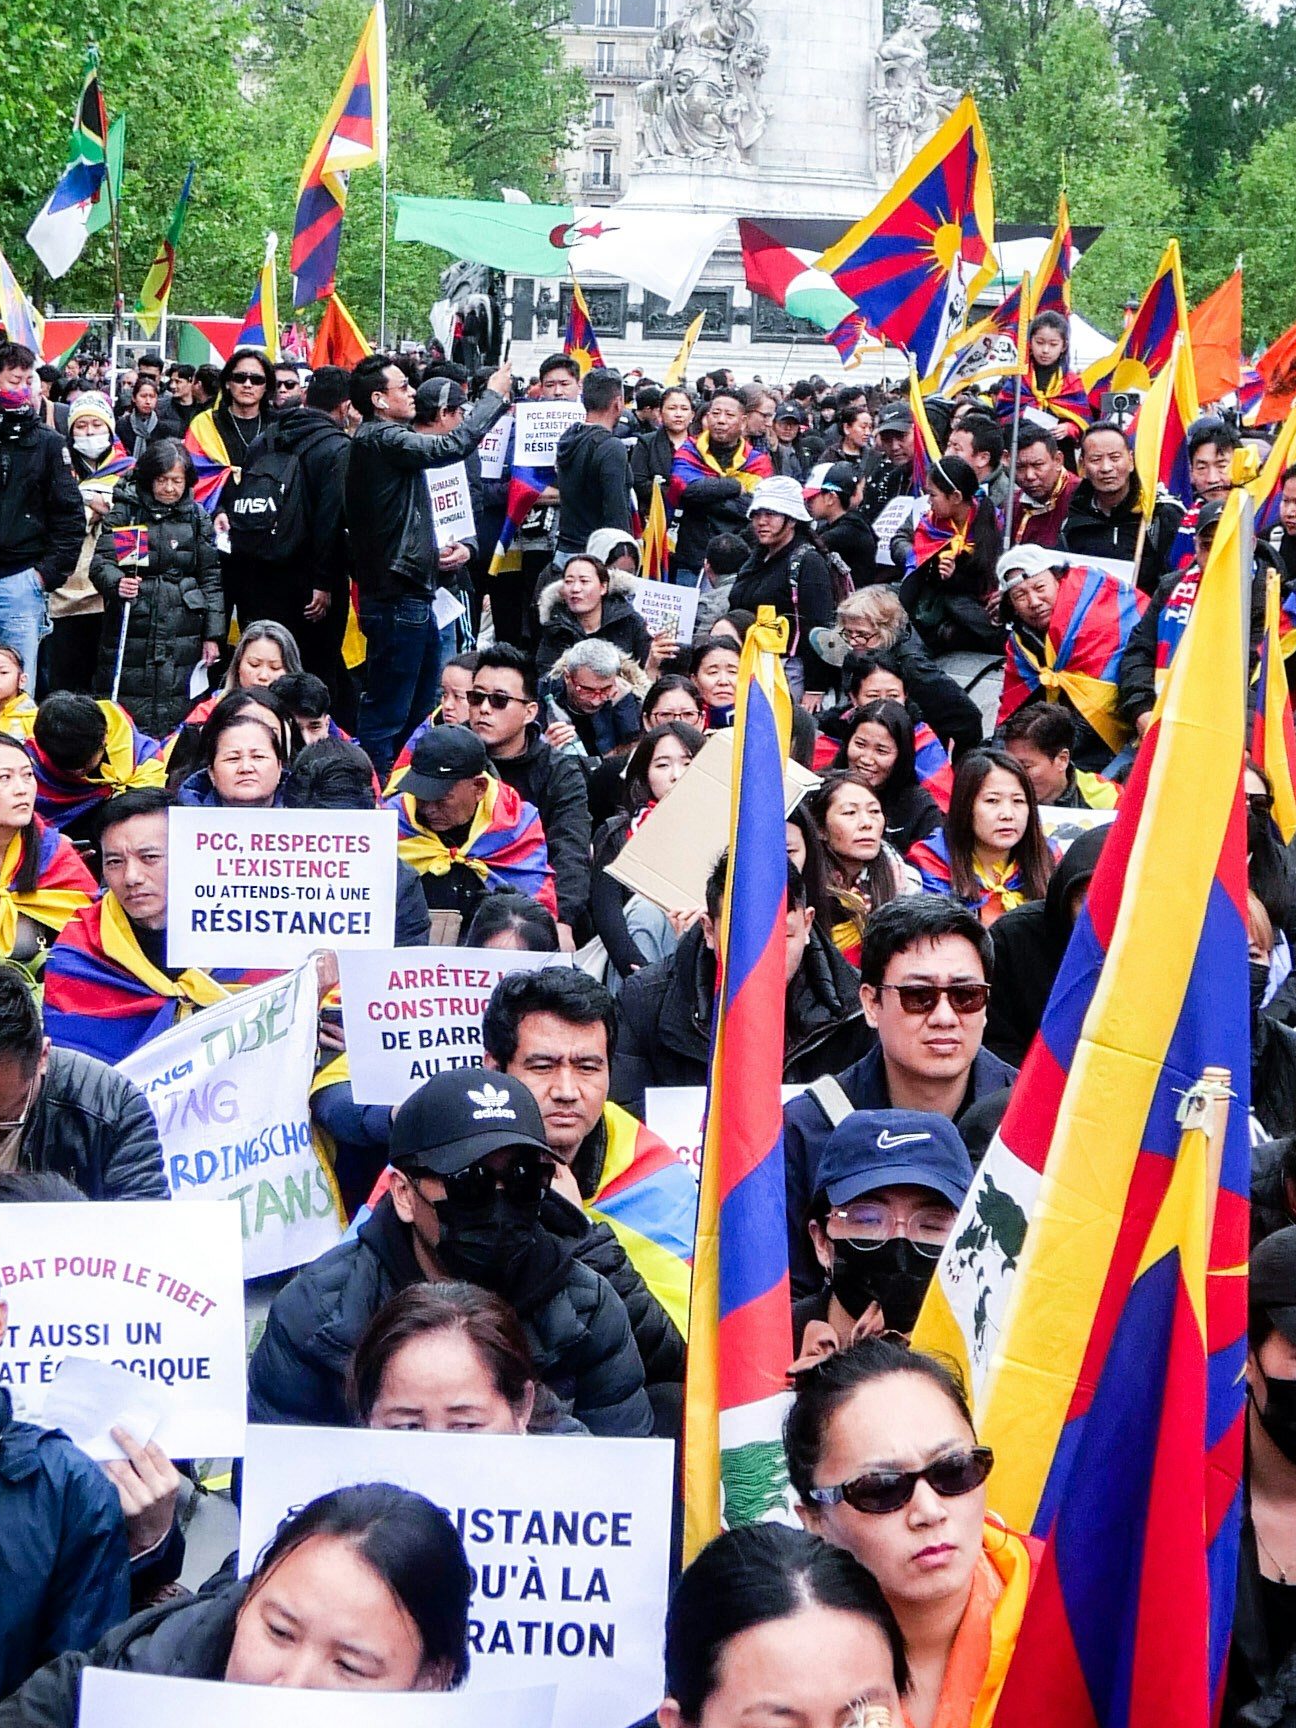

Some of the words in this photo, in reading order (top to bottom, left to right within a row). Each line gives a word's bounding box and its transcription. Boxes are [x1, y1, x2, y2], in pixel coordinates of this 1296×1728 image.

[234, 497, 277, 514] NASA
[196, 832, 244, 854] PCC,
[250, 833, 371, 853] RESPECTES
[216, 858, 350, 878] L'EXISTENCE
[194, 885, 216, 898] OU
[221, 885, 321, 900] ATTENDS-TOI
[325, 883, 336, 900] À
[340, 887, 371, 901] UNE
[191, 903, 372, 935] RÉSISTANCE!
[388, 964, 491, 991] ARRÊTEZ
[381, 1031, 412, 1050] DE
[410, 1059, 440, 1080] AU
[473, 1106, 516, 1120] adidas
[54, 1256, 117, 1279] POUR
[122, 1263, 151, 1287] LE
[156, 1272, 217, 1317] TIBET
[29, 1323, 110, 1347] AUSSI
[126, 1322, 162, 1345] UN
[561, 1566, 611, 1603] LA
